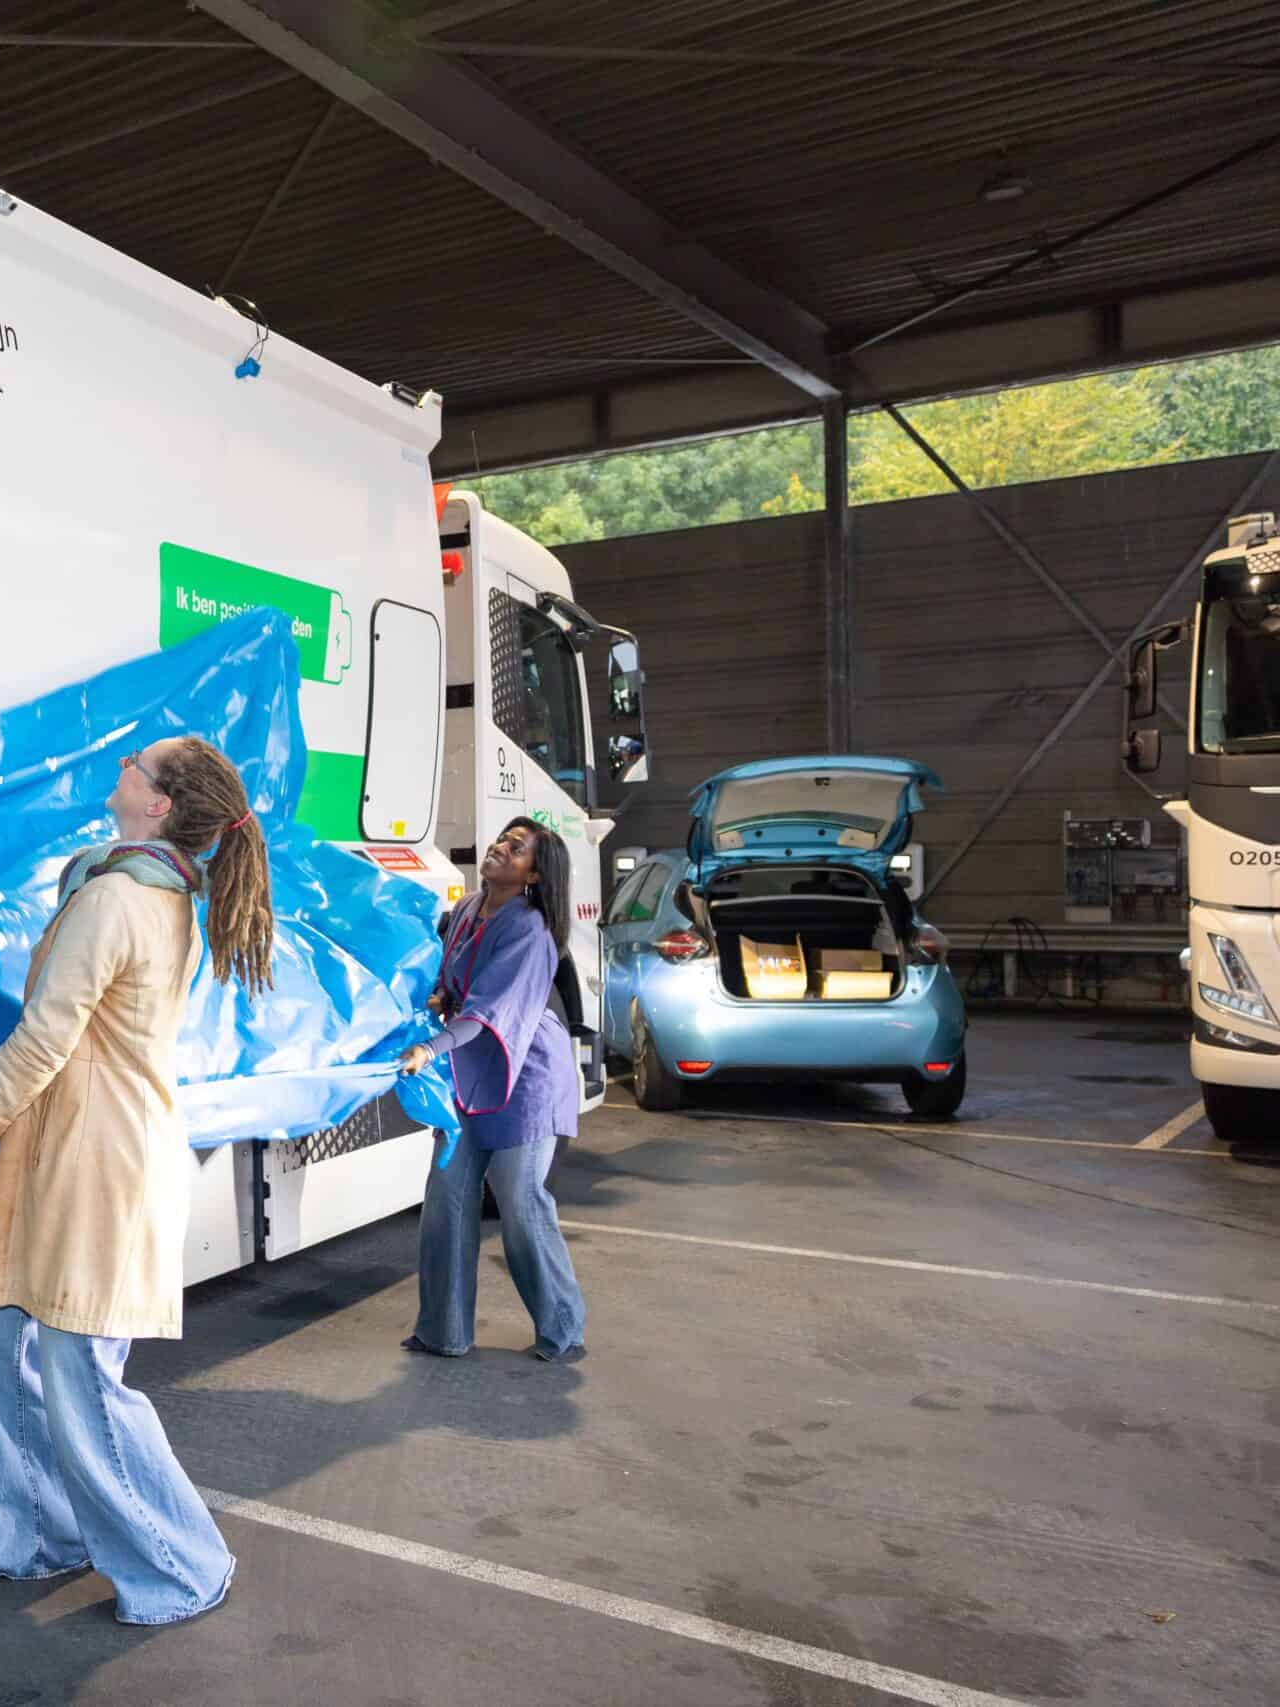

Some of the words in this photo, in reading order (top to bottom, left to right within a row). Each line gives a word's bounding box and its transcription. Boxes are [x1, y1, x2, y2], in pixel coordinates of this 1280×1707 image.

[176, 585, 189, 610] Ik
[192, 589, 217, 616] ben
[499, 771, 517, 793] 219
